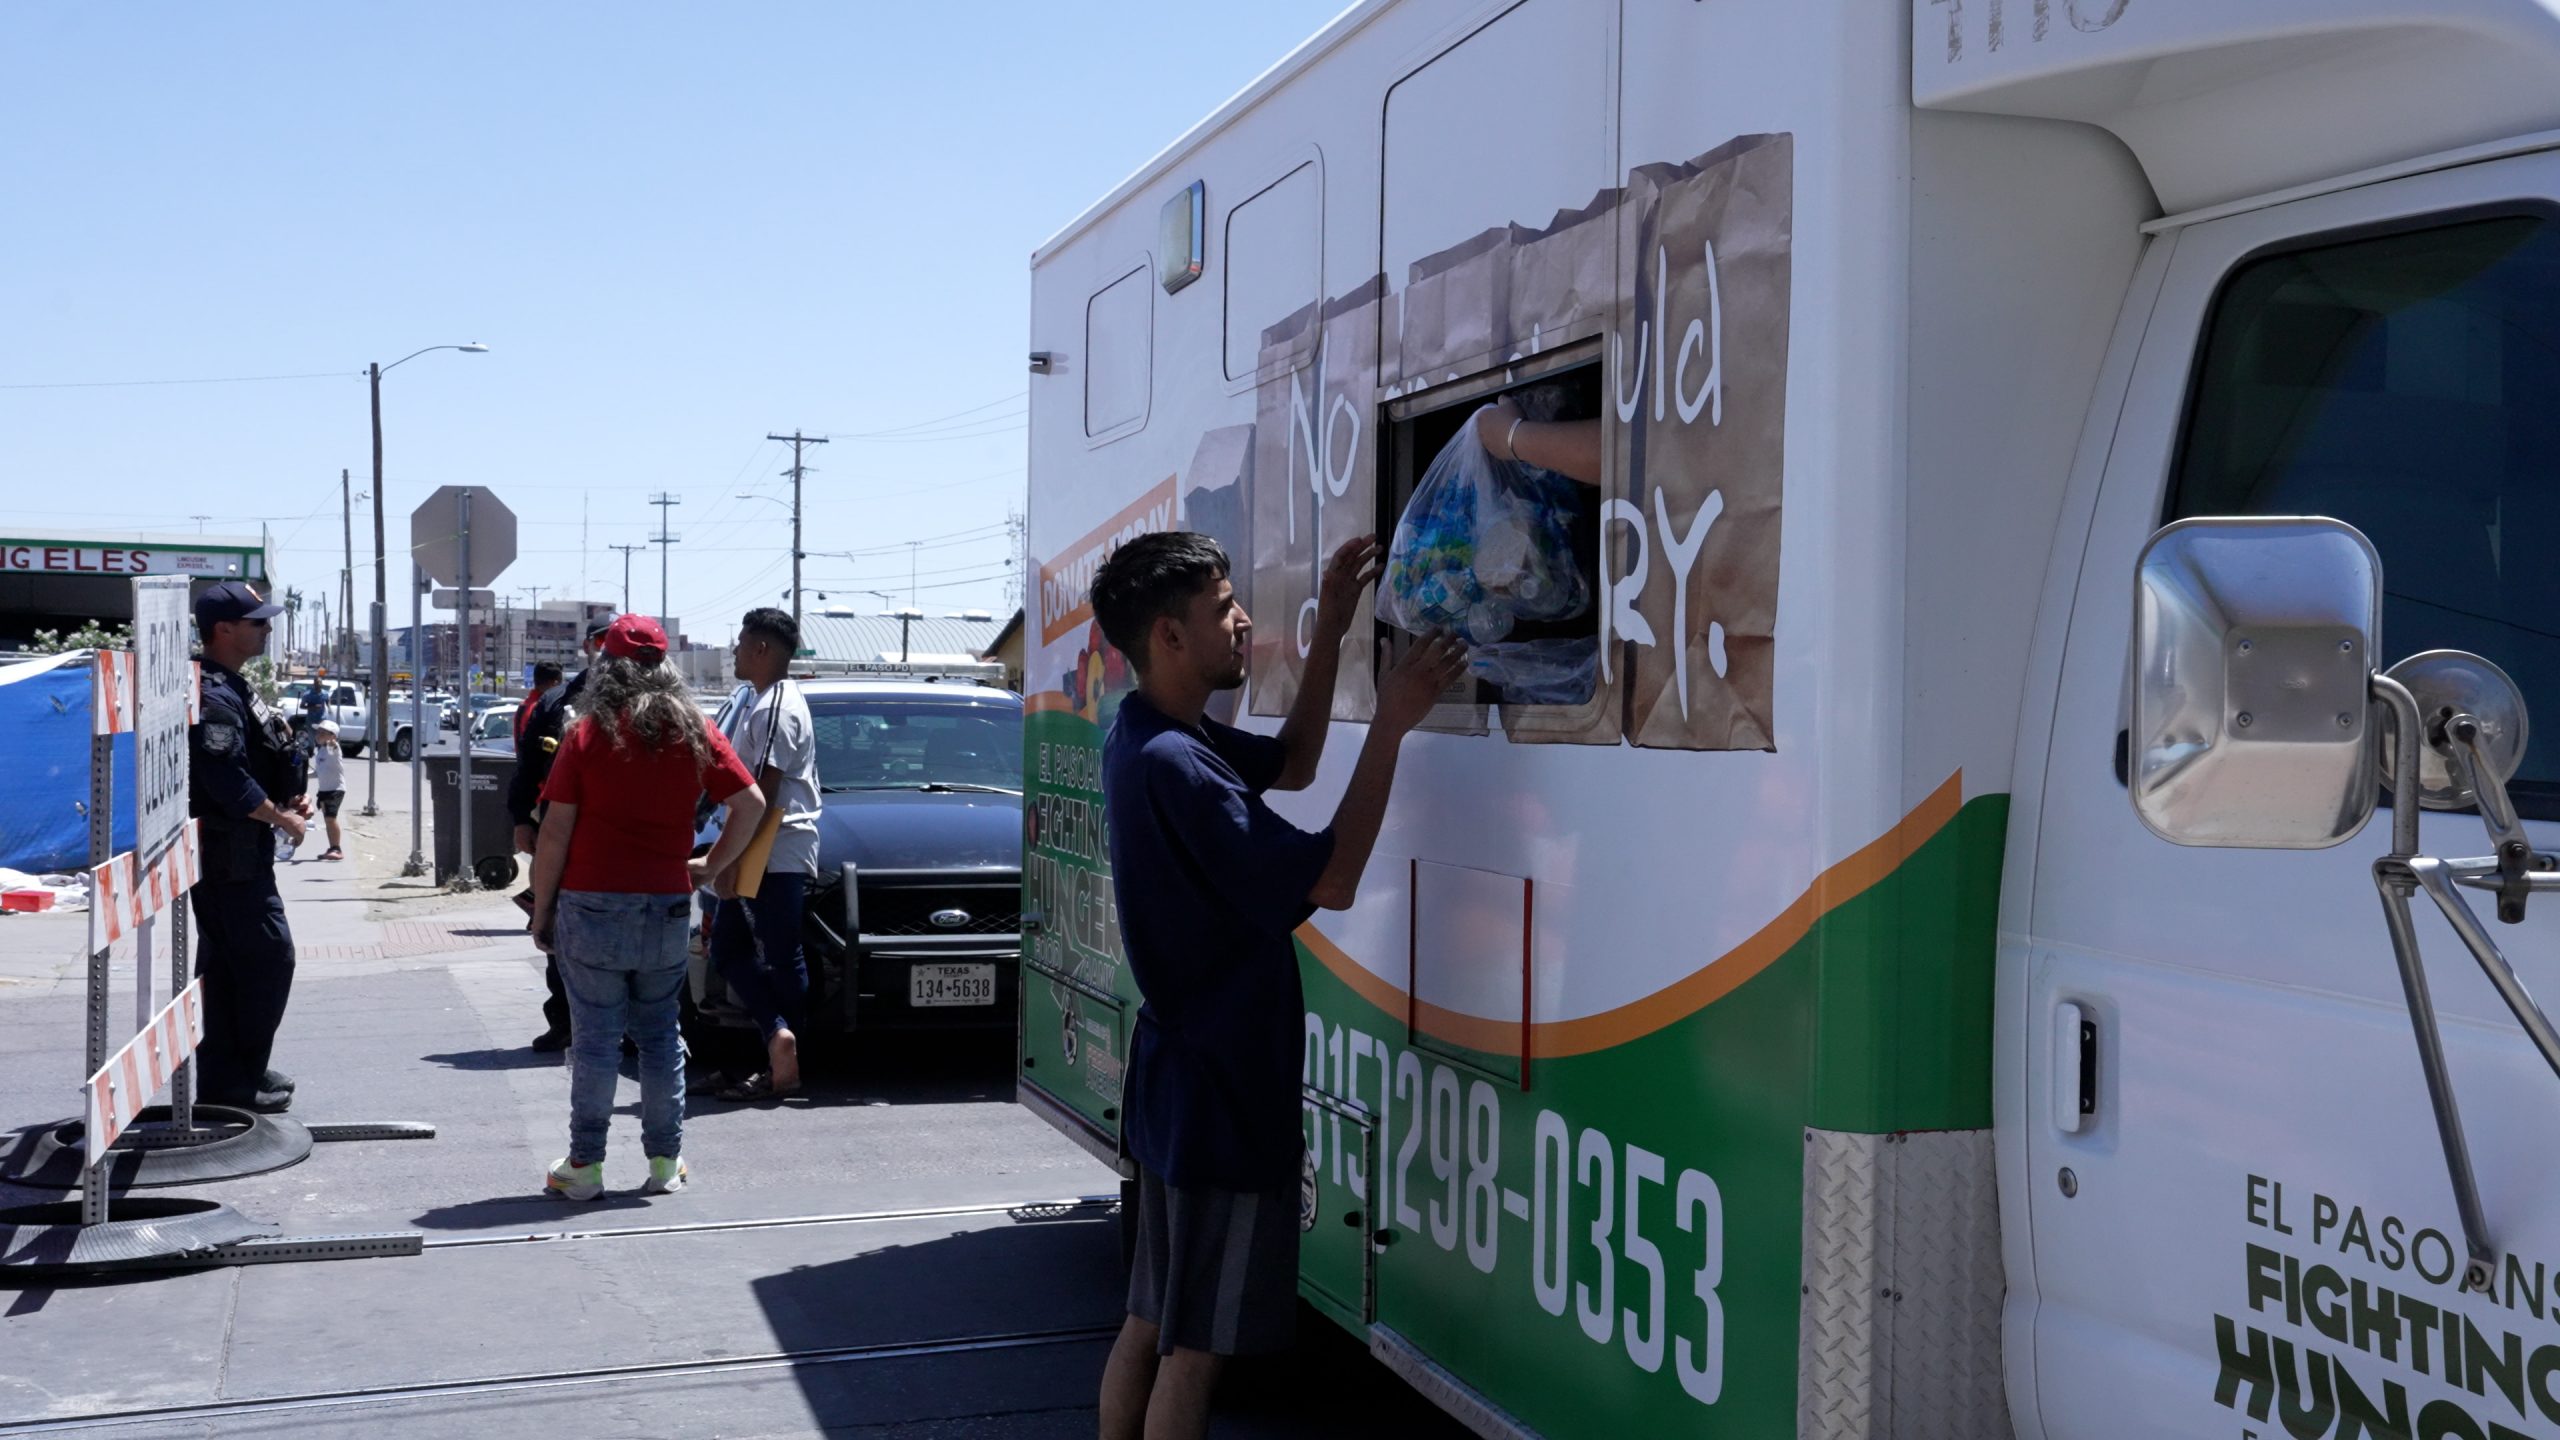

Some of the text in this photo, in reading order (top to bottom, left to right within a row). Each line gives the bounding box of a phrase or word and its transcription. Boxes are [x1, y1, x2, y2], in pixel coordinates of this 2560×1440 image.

[1288, 329, 1361, 545] No
[150, 620, 182, 697] ROAD
[865, 664, 892, 672] PASO
[895, 664, 909, 672] PD
[144, 726, 185, 816] CLOSED
[1040, 742, 1104, 793] EL PASOAN
[1028, 851, 1123, 965] HUNGER
[938, 966, 970, 975] TEXAS
[2247, 1172, 2560, 1327] EL PASON
